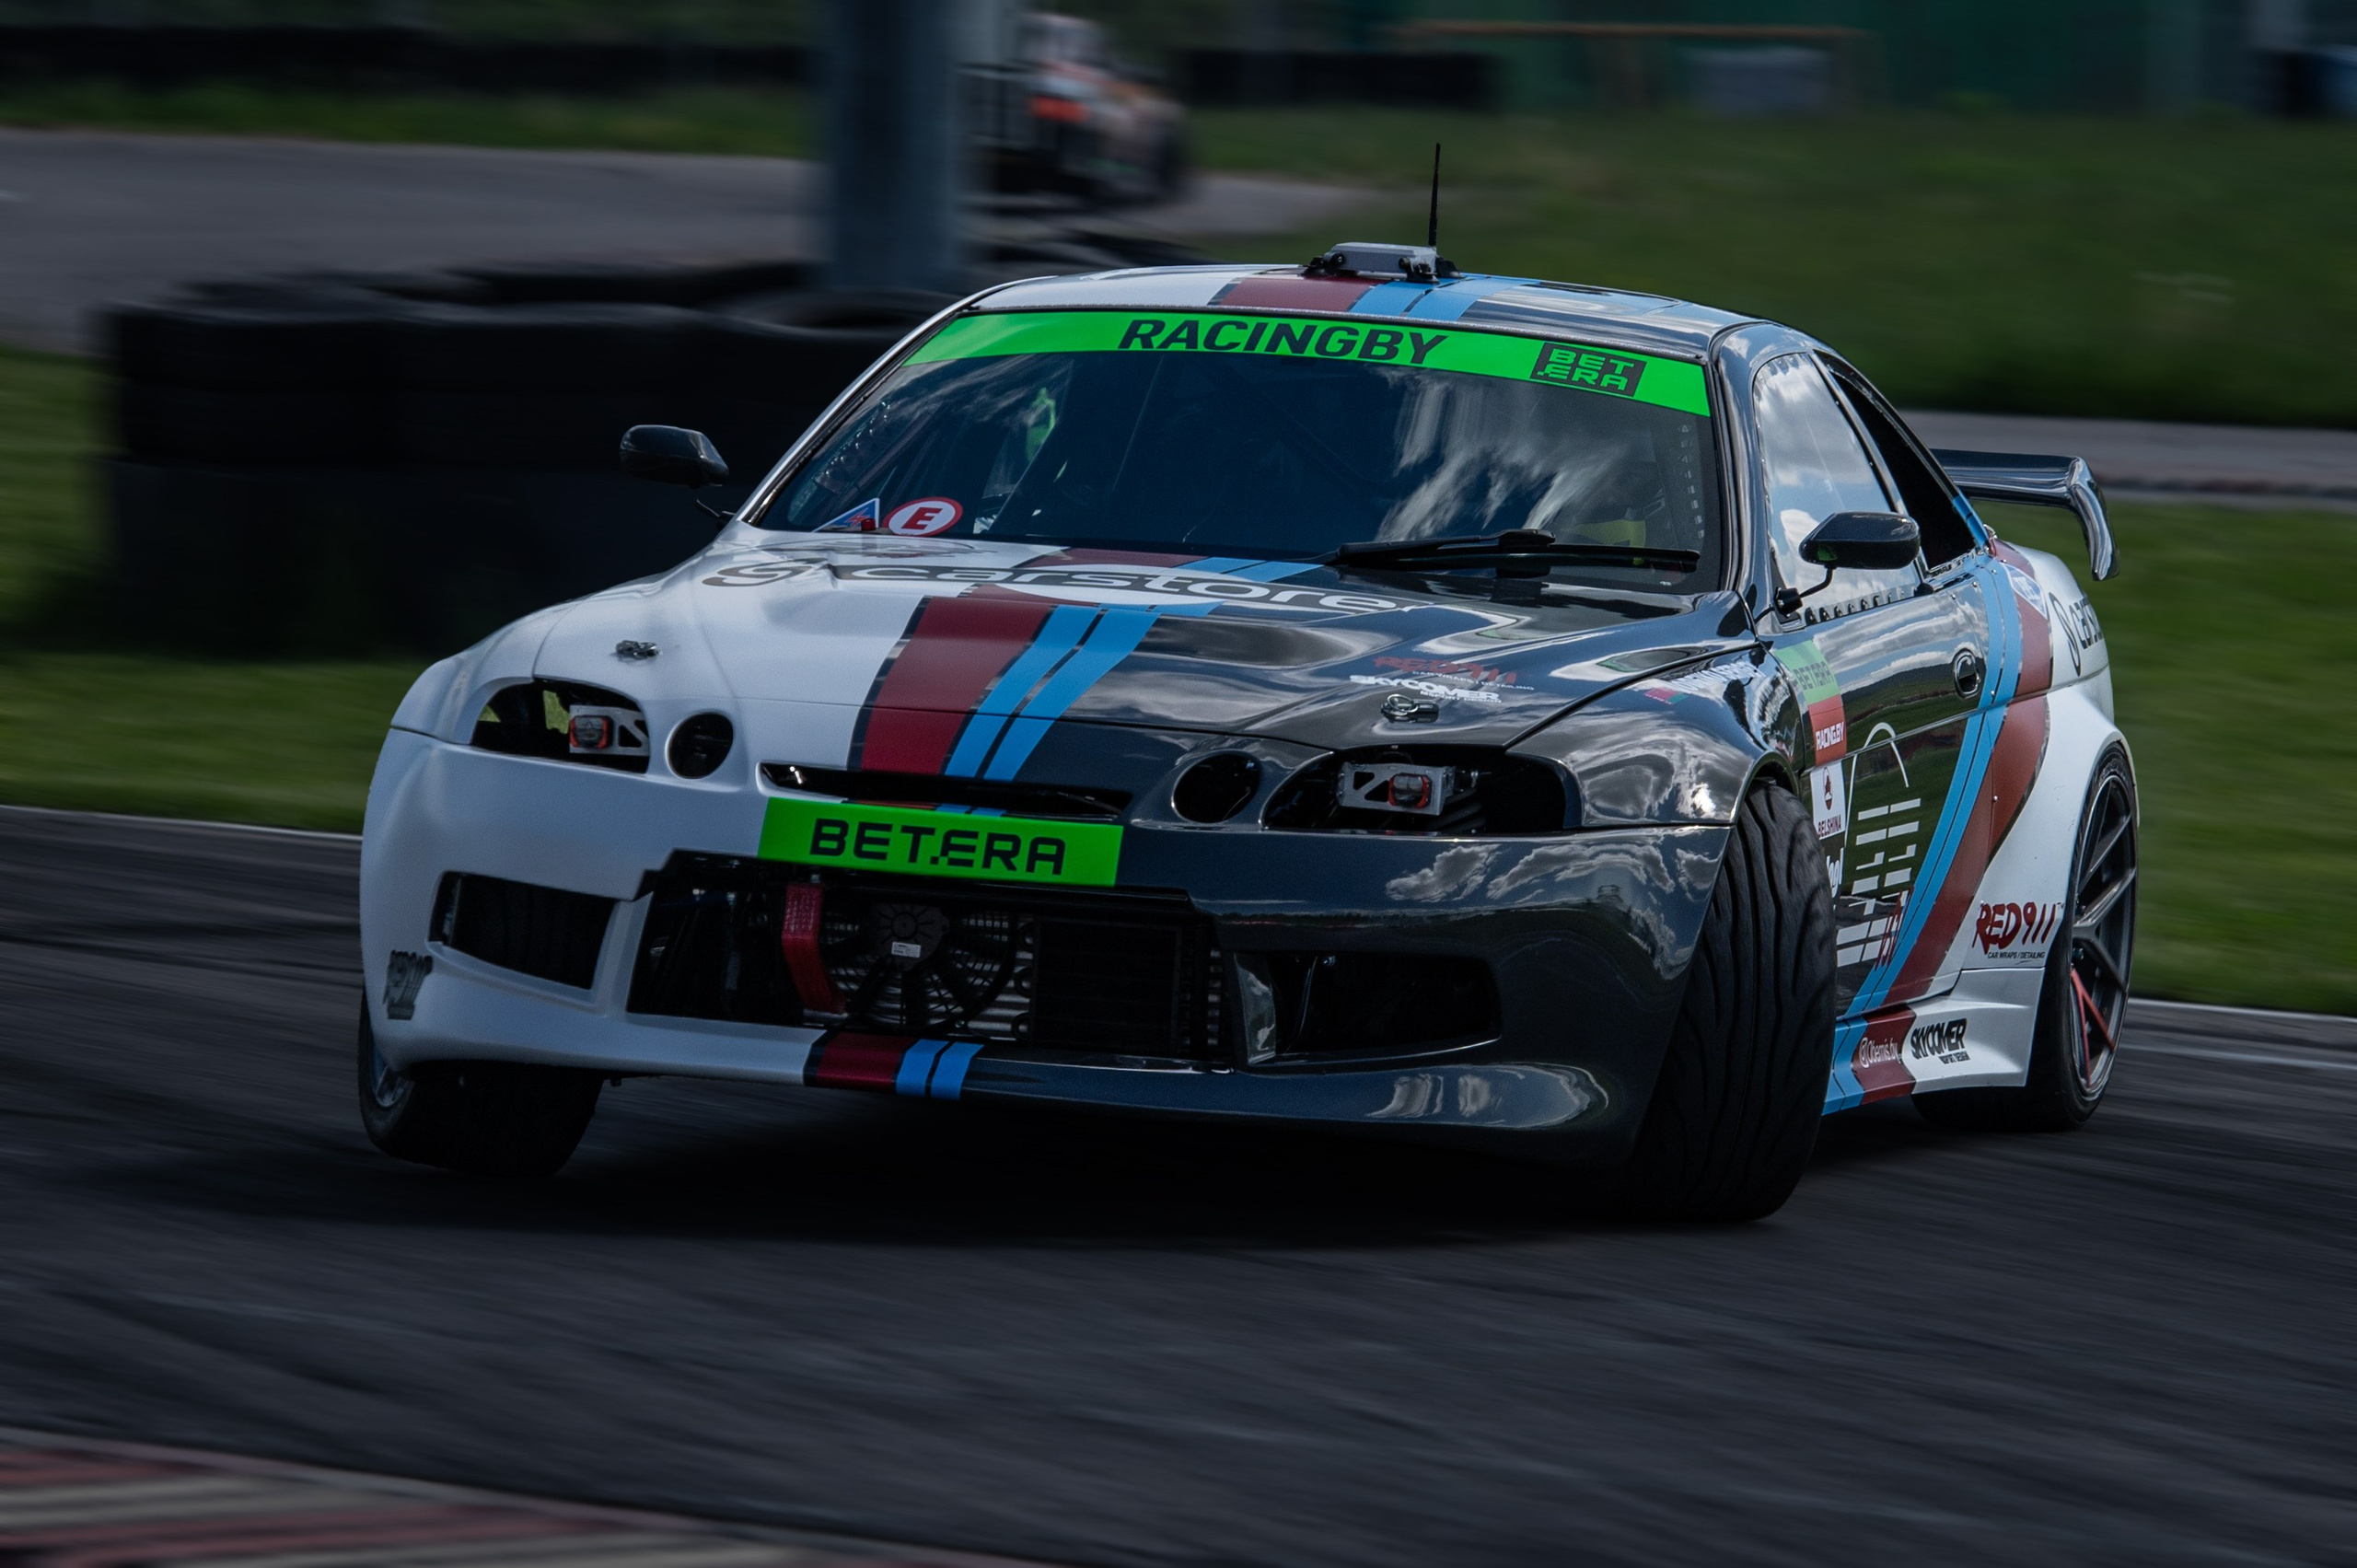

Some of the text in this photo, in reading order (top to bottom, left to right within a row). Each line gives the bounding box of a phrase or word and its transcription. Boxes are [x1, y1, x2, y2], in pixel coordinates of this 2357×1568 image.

[1117, 319, 1449, 365] RACINGBY
[1549, 348, 1635, 375] BET
[900, 506, 943, 530] E
[1971, 901, 2056, 955] RED911
